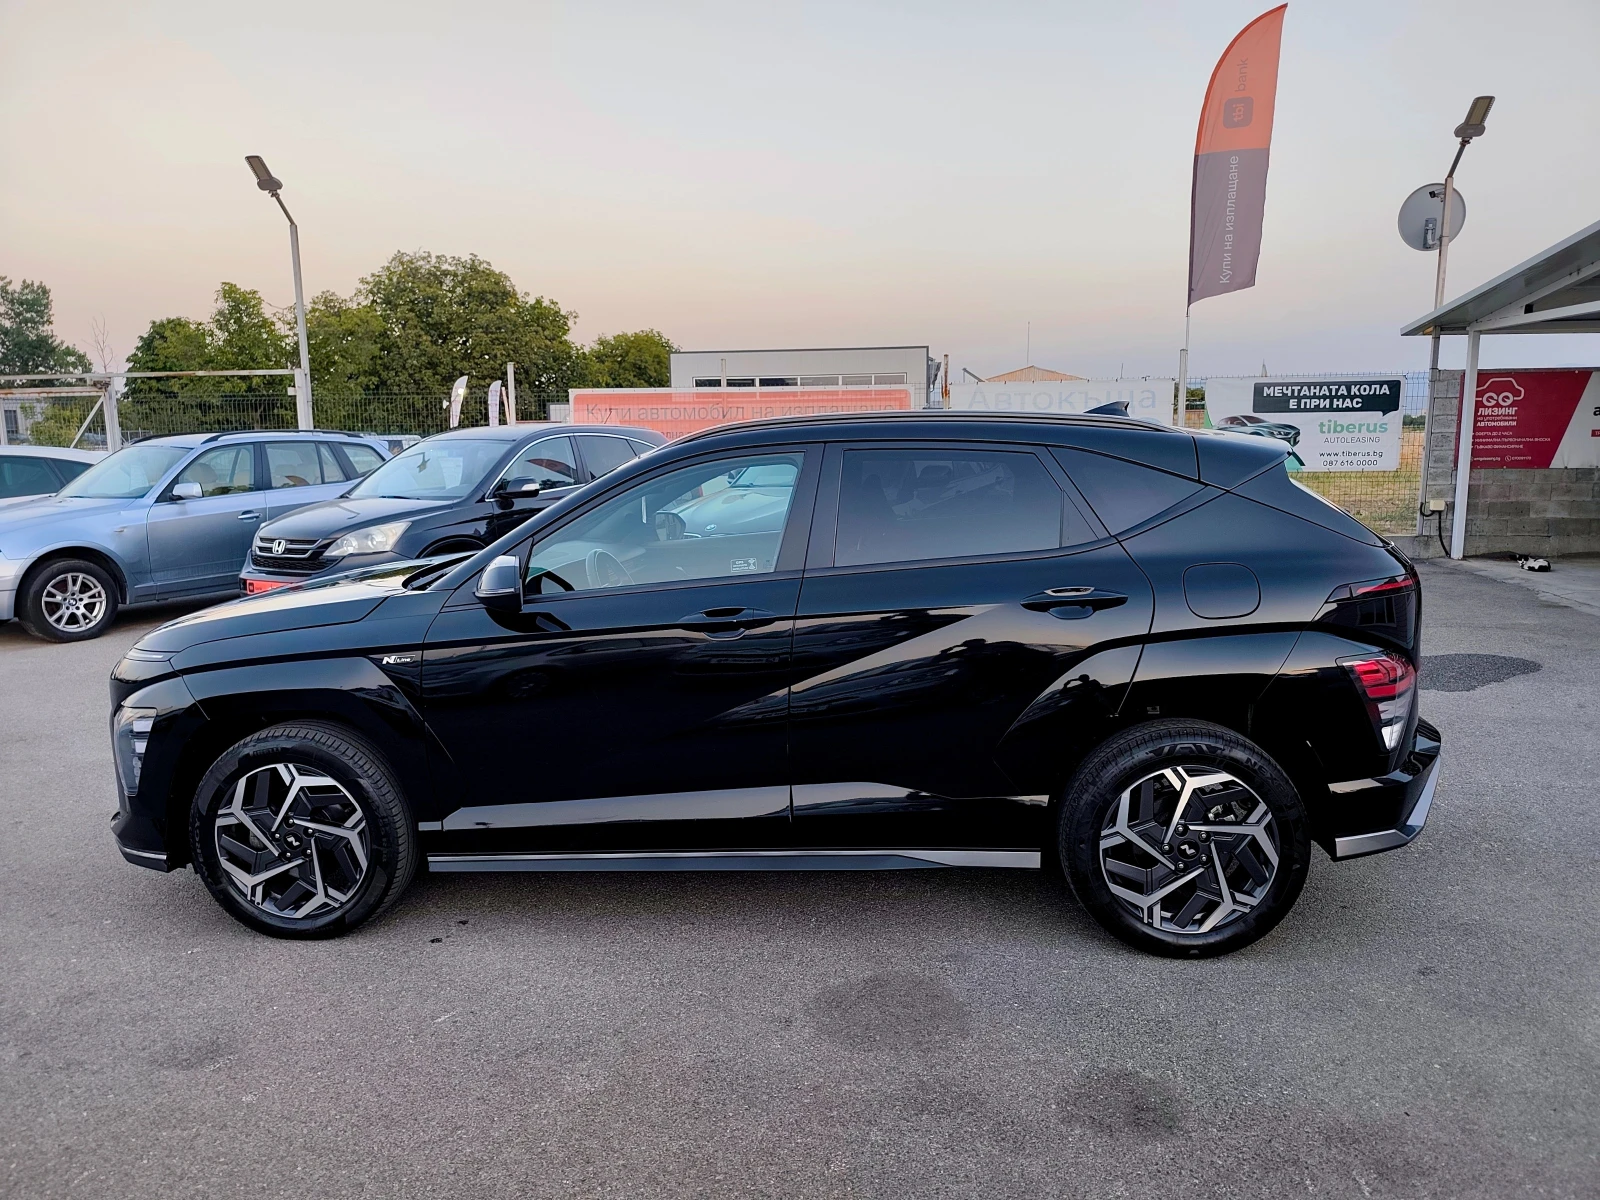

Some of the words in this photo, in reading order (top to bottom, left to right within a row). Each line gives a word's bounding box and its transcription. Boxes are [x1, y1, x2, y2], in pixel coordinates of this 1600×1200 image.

[1235, 57, 1248, 92] bank
[1233, 103, 1245, 123] tbi
[1226, 155, 1239, 230] изплащане
[1224, 233, 1233, 250] на
[1219, 253, 1233, 284] Купи
[1263, 385, 1347, 397] МЕЧТАНАТА
[1351, 384, 1390, 396] КОЛА
[968, 387, 1156, 414] Автокъща
[1289, 399, 1297, 409] Е
[1300, 398, 1330, 409] ПРИ
[1333, 398, 1363, 408] НАС
[586, 404, 631, 424] Купи
[638, 403, 745, 420] автомобил
[752, 405, 775, 419] на
[1477, 407, 1518, 416] ЛИЗИНГ
[1318, 419, 1388, 434] tiberus
[1323, 436, 1381, 444] AUTOLEASING
[1319, 450, 1383, 458] www.tiberus.bg
